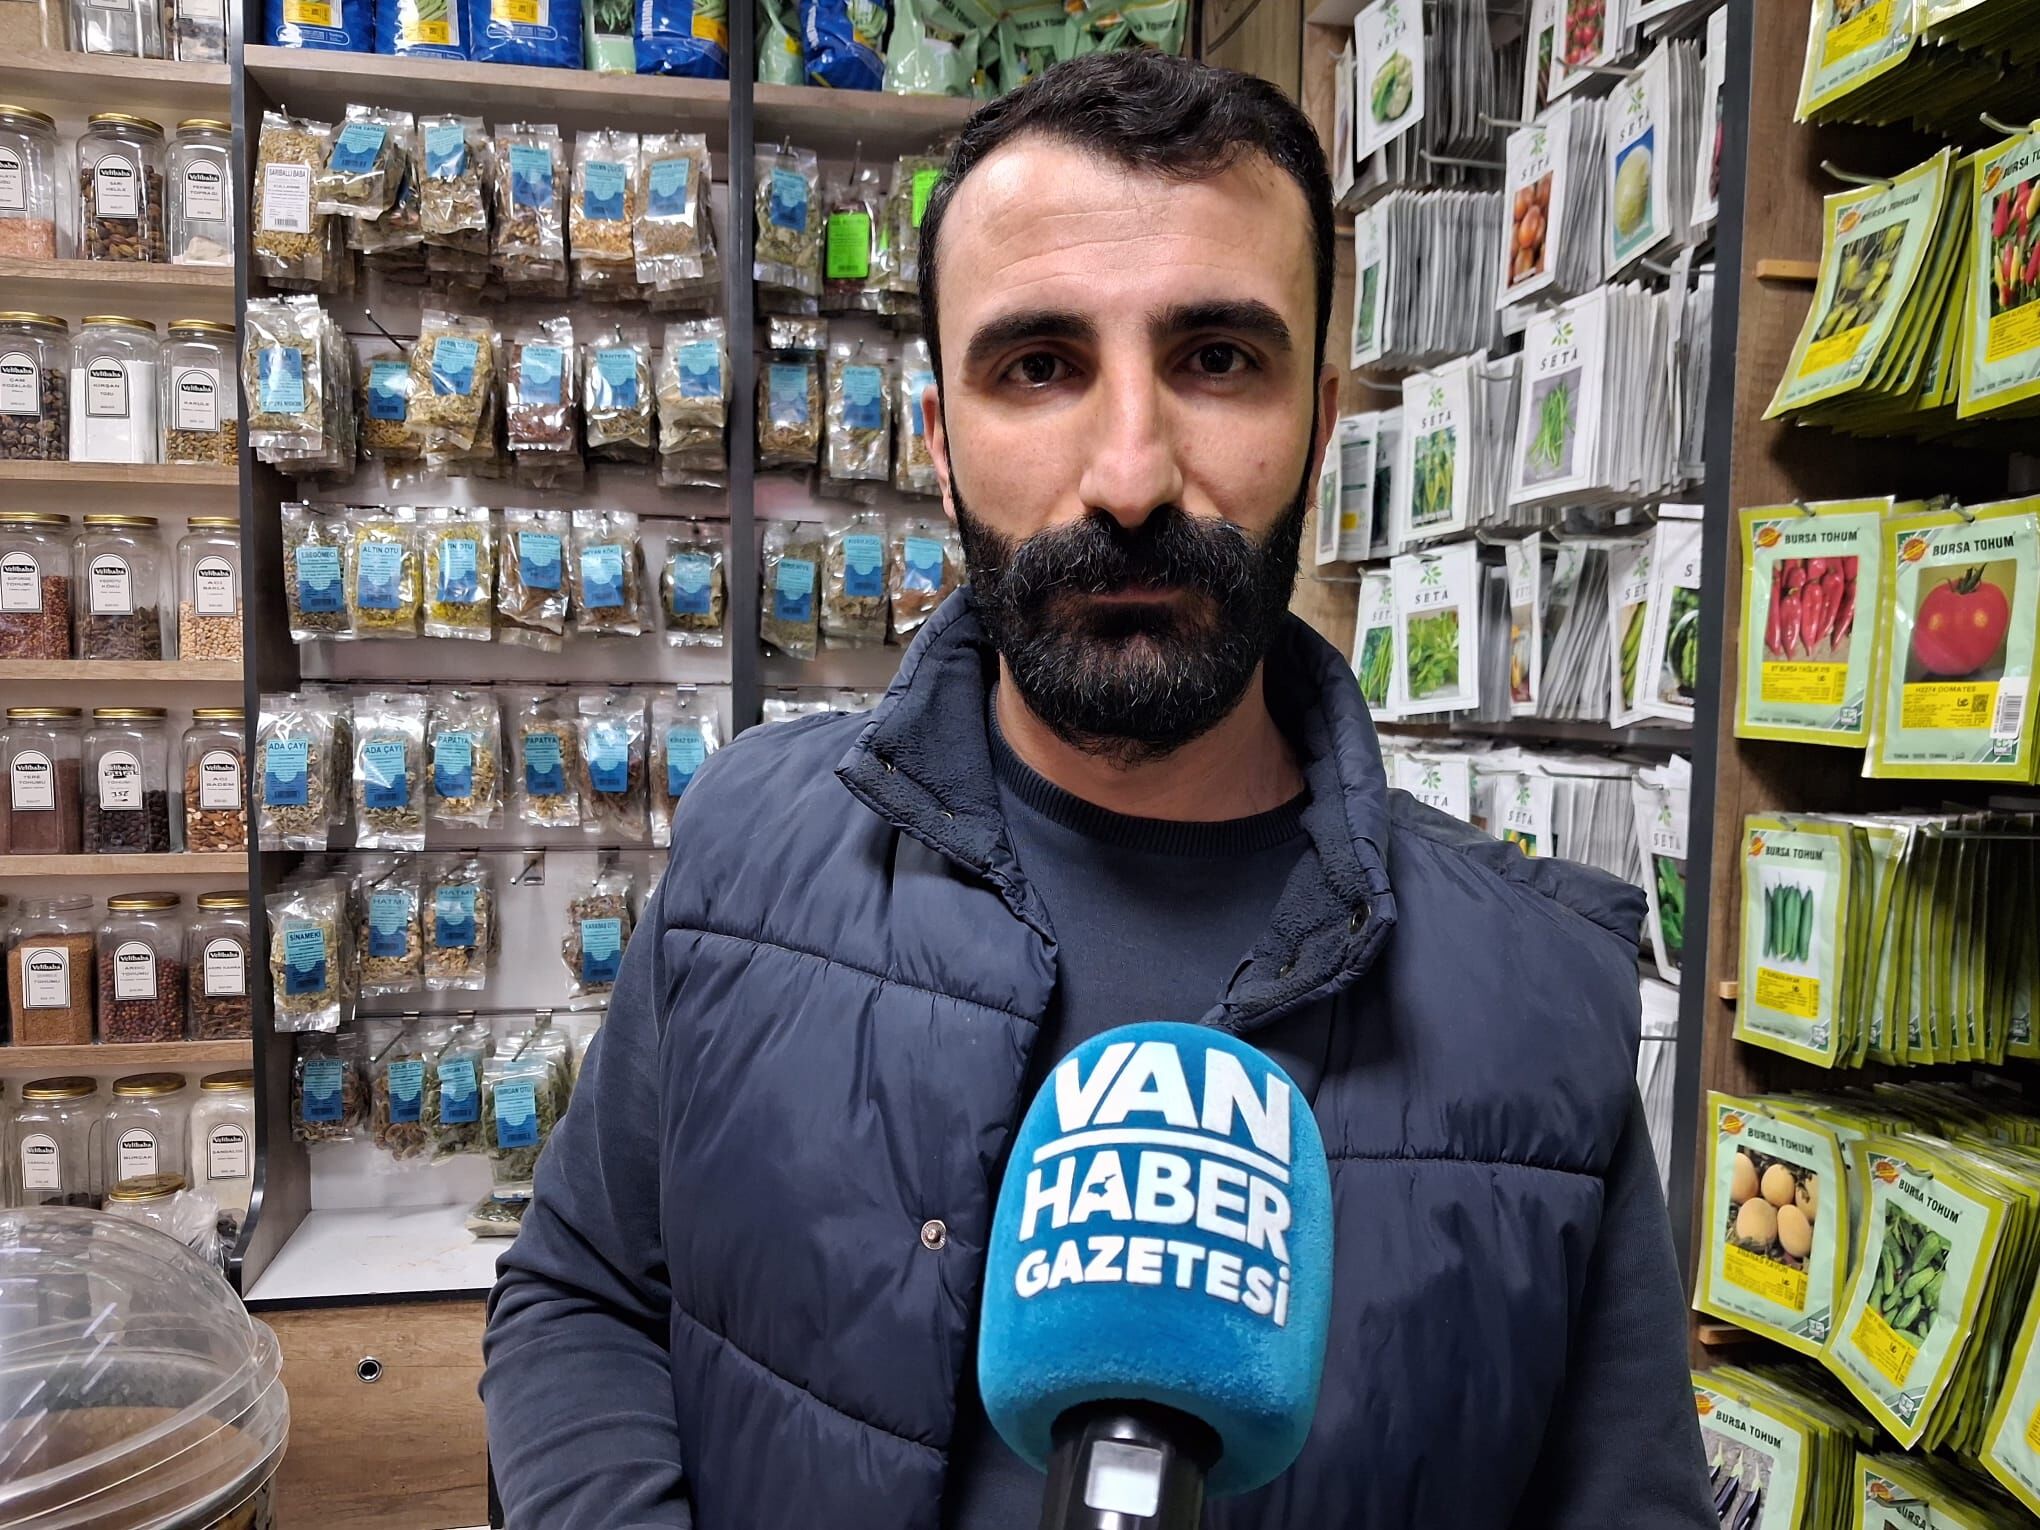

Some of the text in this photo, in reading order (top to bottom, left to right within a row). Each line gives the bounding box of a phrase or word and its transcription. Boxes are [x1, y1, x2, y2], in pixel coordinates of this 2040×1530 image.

[1889, 193, 1920, 212] TOHUM
[1540, 348, 1578, 370] SETA
[1422, 410, 1452, 429] SETA
[1784, 530, 1858, 545] BURSA TOHUM
[1933, 535, 2015, 557] BURSA TOHUM
[1415, 589, 1449, 605] SETA
[1625, 583, 1648, 600] SET
[1938, 685, 1977, 693] DOMATES
[287, 742, 306, 751] ÇAYI
[438, 736, 469, 744] PAPATYA
[365, 745, 402, 754] ADA ÇAYI
[1509, 810, 1532, 825] SETA
[1653, 833, 1681, 850] SETA
[1765, 845, 1824, 861] BURSA TOHUM
[1055, 1041, 1291, 1166] VAN
[1747, 1127, 1814, 1156] BURSA TOHUM
[1018, 1150, 1292, 1266] HABER
[1898, 1178, 1960, 1224] BURSA TOHUM
[1715, 1411, 1782, 1448] BURSA TOHUM
